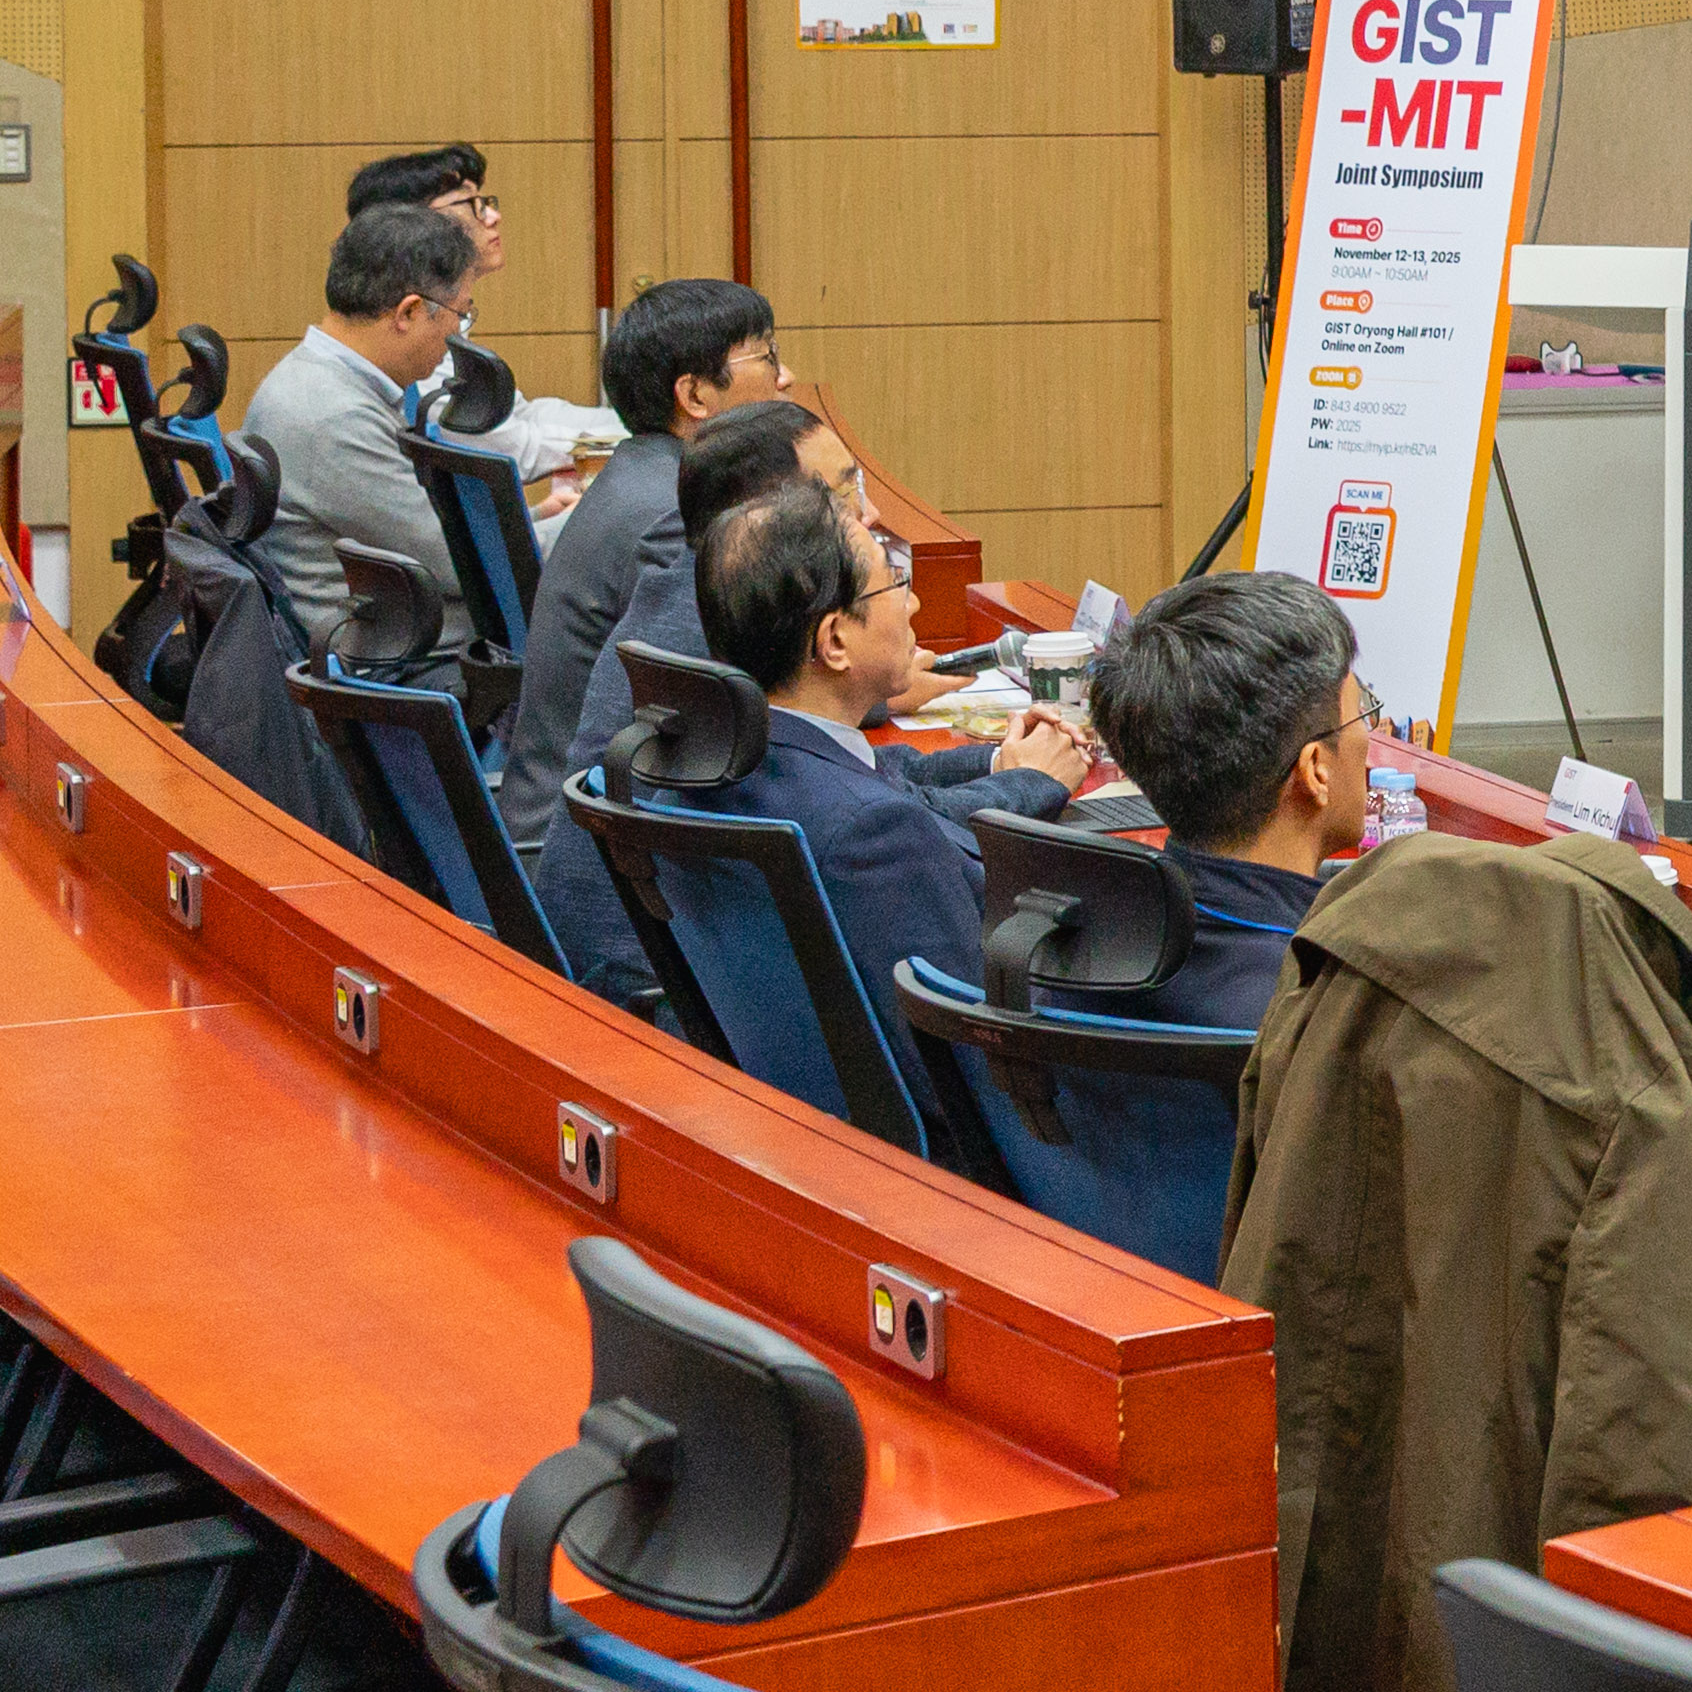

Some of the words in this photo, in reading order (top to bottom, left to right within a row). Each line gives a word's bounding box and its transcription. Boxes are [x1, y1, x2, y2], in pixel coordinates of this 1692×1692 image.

[1341, 78, 1503, 150] -MIT
[1335, 163, 1377, 185] Joint
[1381, 164, 1484, 189] Symposium
[1337, 222, 1362, 234] Time
[1334, 247, 1392, 261] November
[1395, 250, 1427, 265] 12-13,
[1431, 251, 1461, 264] 2025
[1331, 265, 1372, 279] 9:00AM
[1386, 268, 1428, 281] 10:50AM
[1326, 294, 1354, 307] Place
[1325, 322, 1350, 334] GIST
[1354, 323, 1394, 339] Oryong
[1397, 326, 1418, 338] Hall
[1420, 328, 1446, 339] #101
[1321, 339, 1355, 352] Online
[1358, 343, 1371, 354] on
[1374, 342, 1404, 354] Zoom
[1313, 399, 1328, 410] ID:
[1331, 400, 1351, 412] 843
[1353, 402, 1380, 414] 4900
[1310, 418, 1333, 430] PW:
[1336, 419, 1361, 432] 2025
[1308, 437, 1333, 450] Link:
[1346, 489, 1369, 499] SCAN
[1371, 490, 1383, 500] ME
[1573, 801, 1590, 822] Lim
